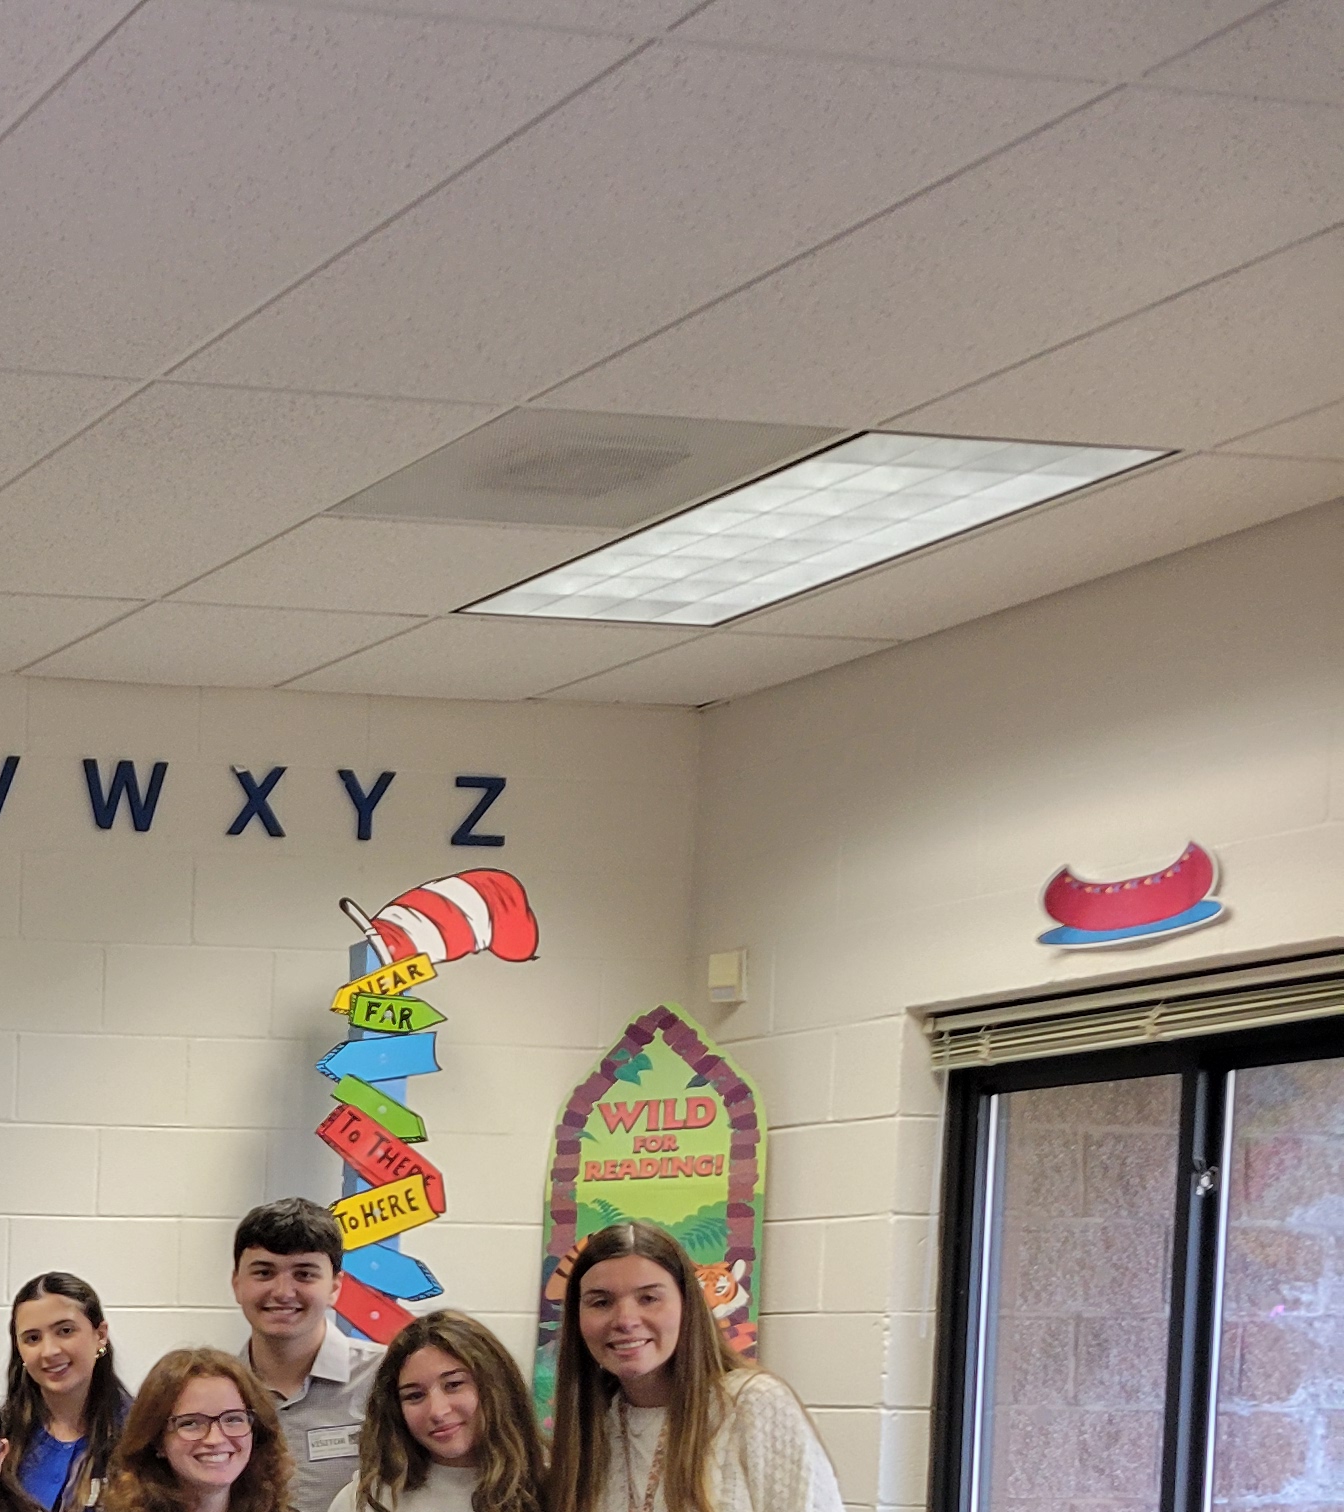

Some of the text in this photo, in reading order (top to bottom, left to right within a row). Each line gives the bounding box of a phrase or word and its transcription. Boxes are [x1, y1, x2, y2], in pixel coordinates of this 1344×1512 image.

[82, 758, 169, 833] W
[226, 766, 287, 838] X
[337, 769, 396, 841] Y
[450, 775, 506, 847] Z
[356, 963, 425, 995] NEAR
[364, 1001, 413, 1030] FAR
[597, 1096, 717, 1134] WILD
[632, 1134, 679, 1153] FOR
[583, 1154, 725, 1181] READING!
[335, 1187, 420, 1235] To HERE
